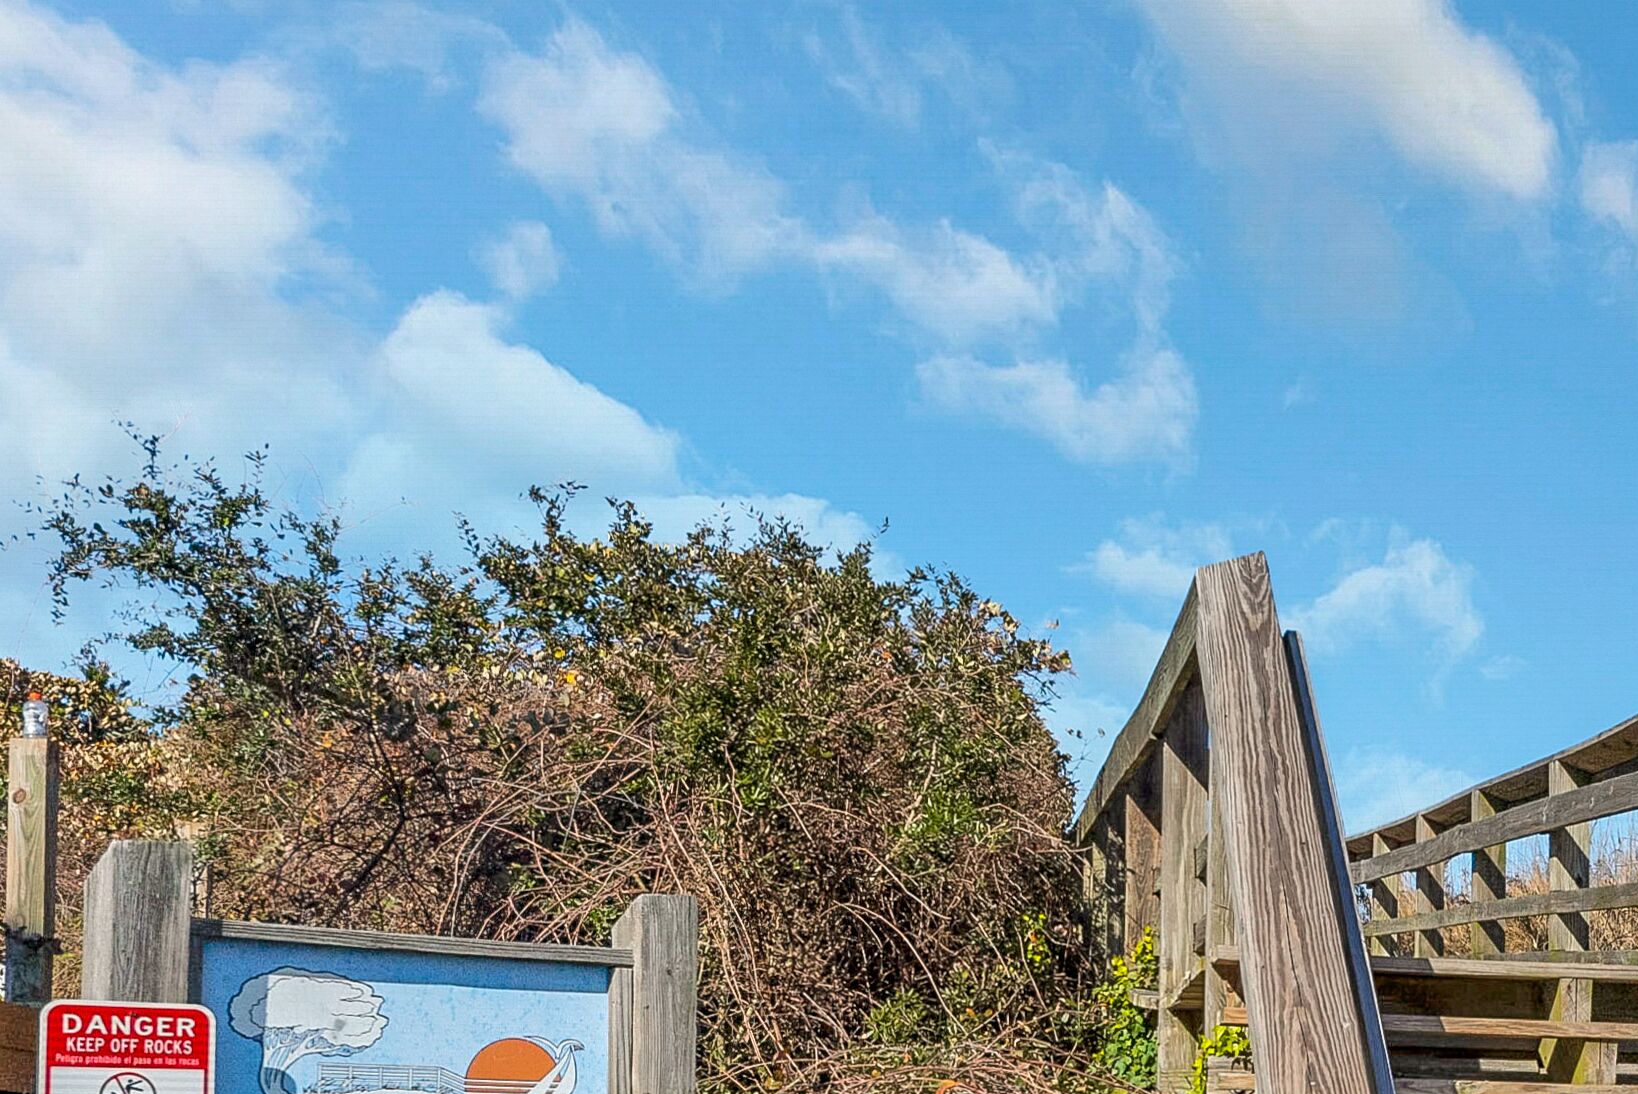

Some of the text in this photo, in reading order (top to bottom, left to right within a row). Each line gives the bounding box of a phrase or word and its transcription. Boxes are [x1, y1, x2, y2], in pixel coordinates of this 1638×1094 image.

[62, 1013, 196, 1038] DANGER
[66, 1037, 192, 1055] KEEP OFF ROCKS
[55, 1053, 200, 1066] Peligro prohibido el paso en las rocas
